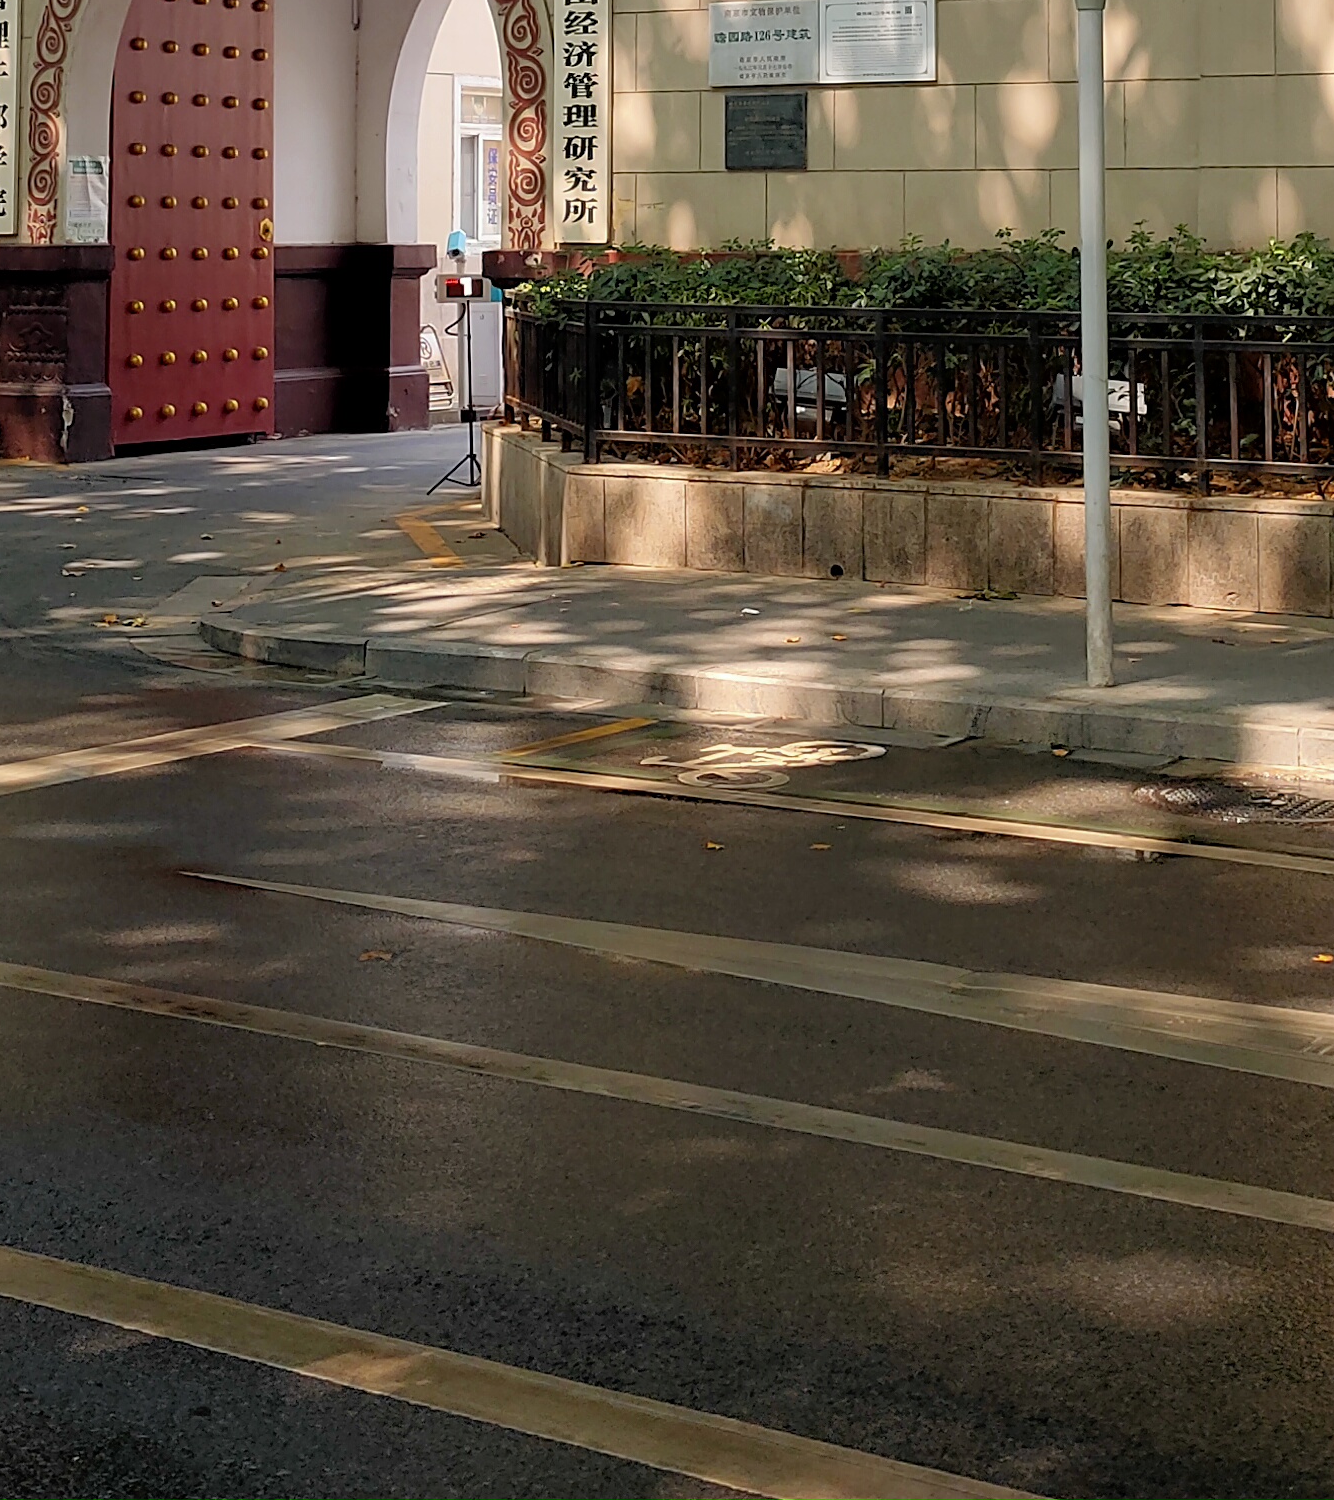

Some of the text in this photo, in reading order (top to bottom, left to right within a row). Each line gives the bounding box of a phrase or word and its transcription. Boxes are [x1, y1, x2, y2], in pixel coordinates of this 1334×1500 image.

[724, 6, 801, 18] 南京市文物保护单位
[714, 28, 811, 43] 瞻园路126号建筑
[487, 147, 498, 225] 保安员证
